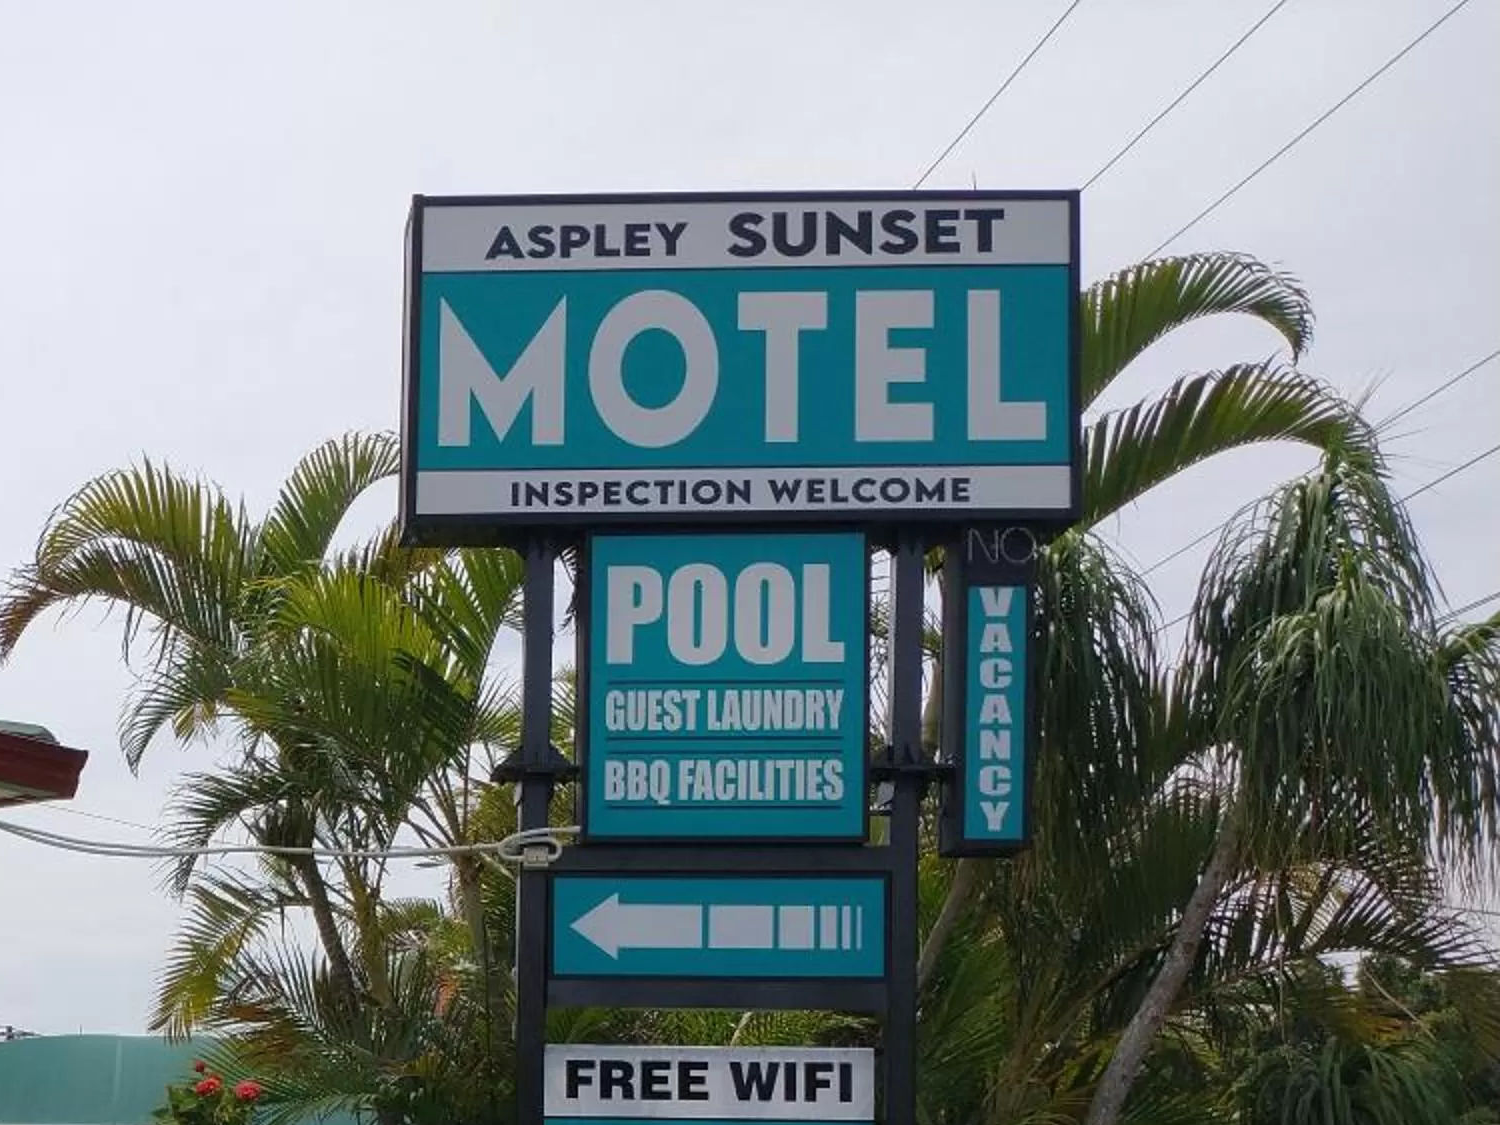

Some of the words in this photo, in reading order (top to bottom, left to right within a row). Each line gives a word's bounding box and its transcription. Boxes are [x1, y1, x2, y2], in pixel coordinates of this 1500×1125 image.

[484, 221, 690, 261] ASPLEY
[726, 208, 1006, 258] SUNSET
[437, 288, 1048, 450] MOTEL
[510, 478, 753, 508] INSPECTION
[766, 476, 972, 505] WELCOME
[967, 526, 1037, 564] NO
[606, 562, 846, 666] POOL
[604, 688, 701, 733] GUEST
[706, 687, 846, 732] LAUNDRY
[978, 586, 1014, 832] VACANCY
[603, 759, 671, 806] BBQ
[678, 758, 846, 802] FACILITIES
[564, 1059, 710, 1101] FREE
[729, 1061, 853, 1103] WIFI
